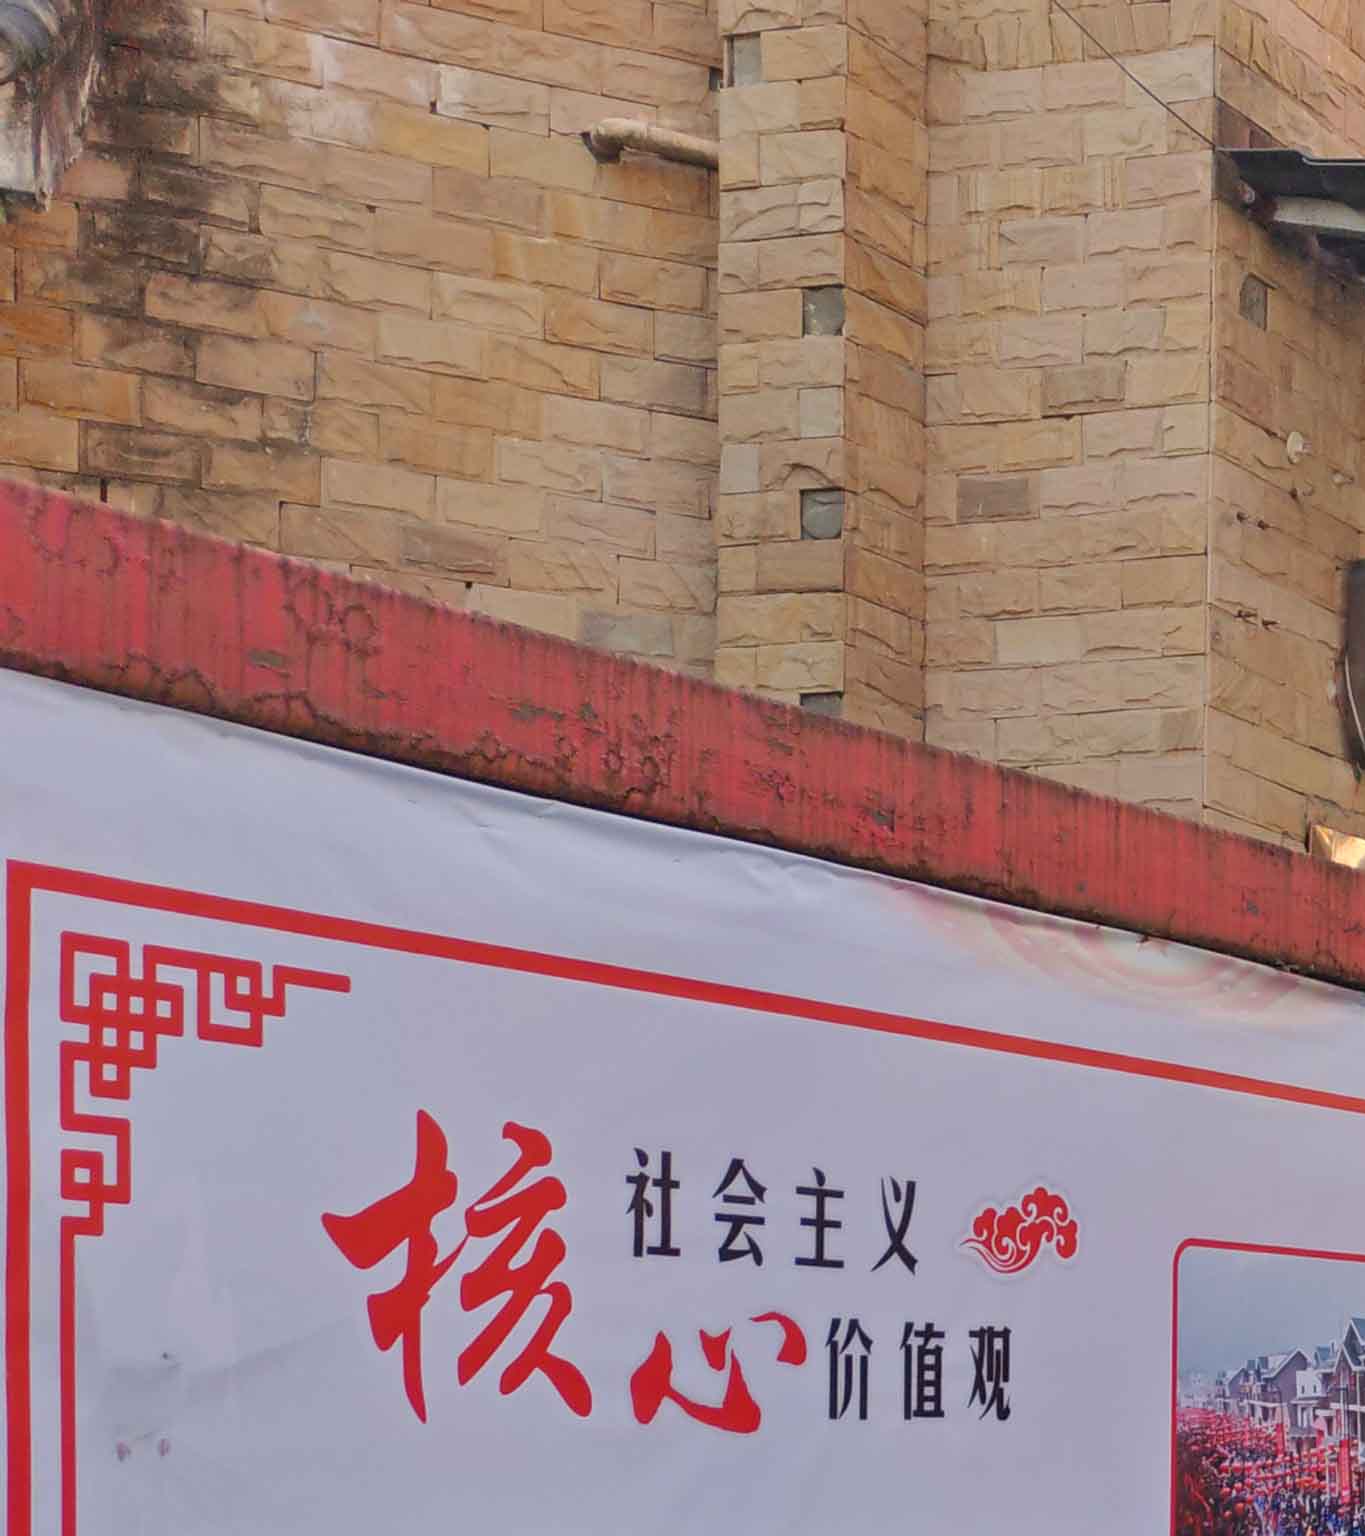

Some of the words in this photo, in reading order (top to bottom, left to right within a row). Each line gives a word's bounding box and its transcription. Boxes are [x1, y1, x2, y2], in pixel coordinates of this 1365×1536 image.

[624, 1147, 920, 1276] 社会主义
[824, 1316, 1013, 1424] 价值观
